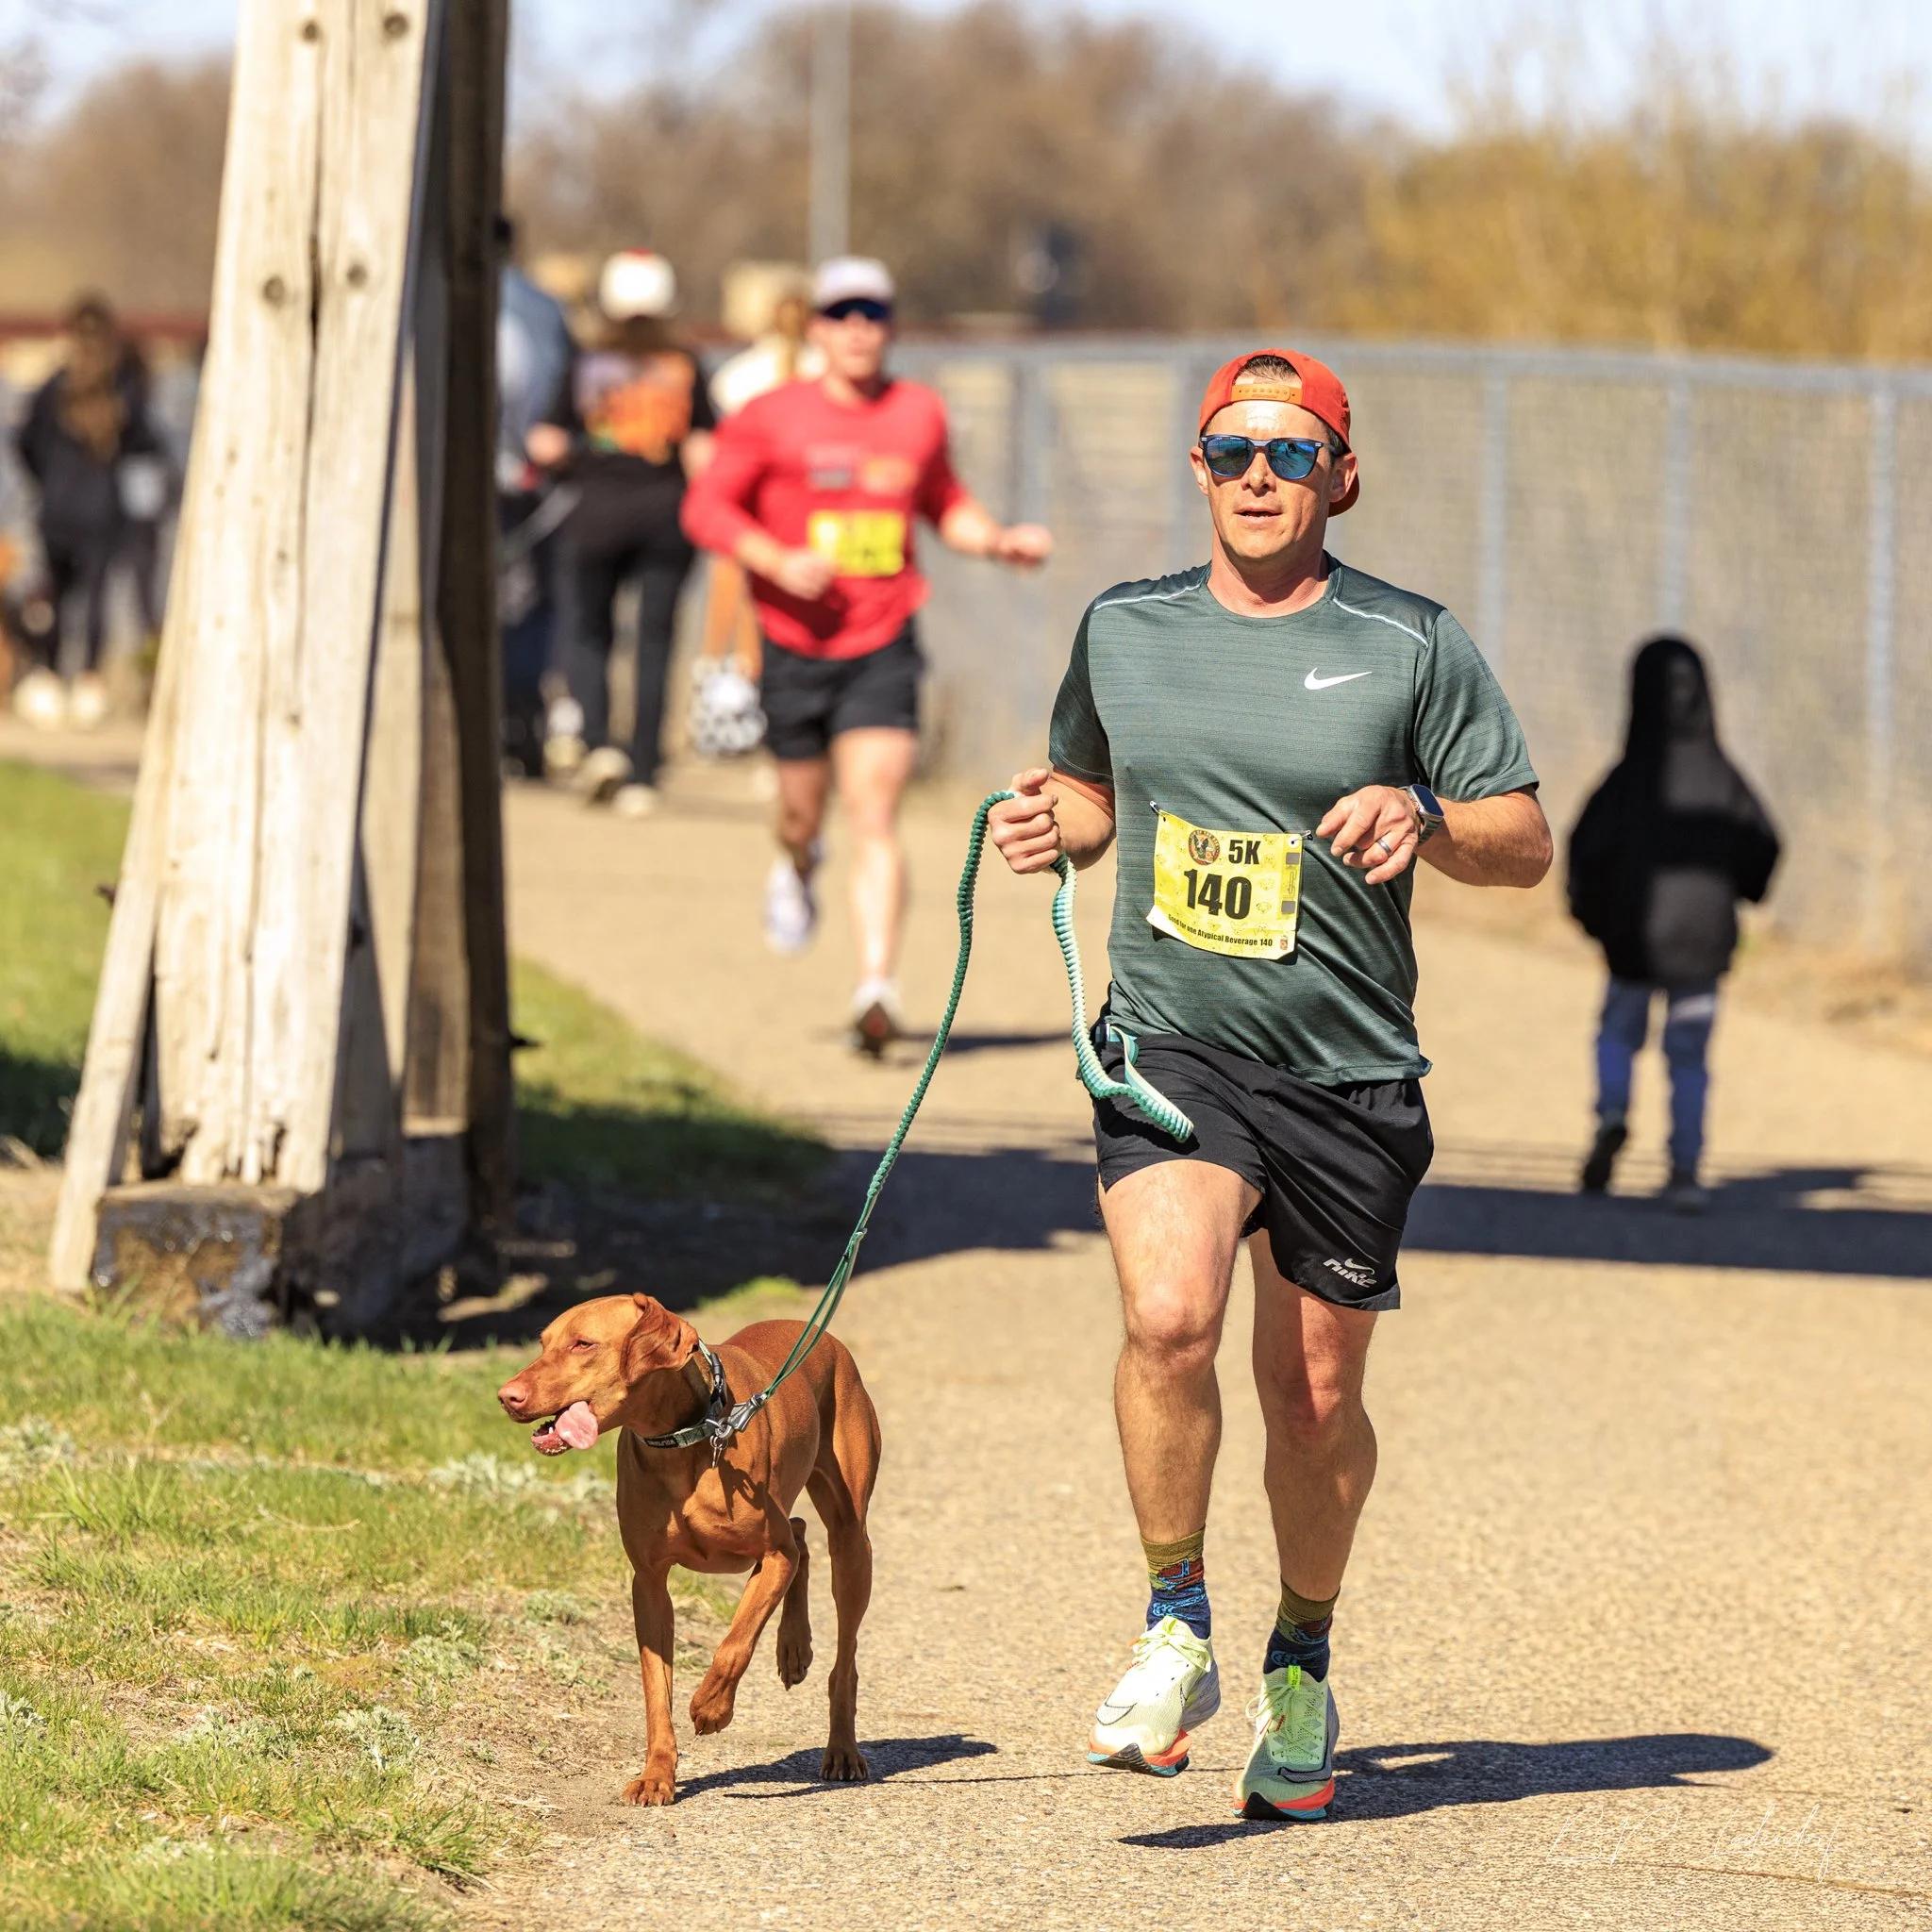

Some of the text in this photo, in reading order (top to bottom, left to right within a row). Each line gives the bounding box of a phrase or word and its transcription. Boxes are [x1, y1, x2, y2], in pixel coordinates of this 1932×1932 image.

[1228, 840, 1261, 865] 5K
[1184, 868, 1252, 920] 140
[1187, 926, 1196, 935] one
[1197, 929, 1224, 941] Atypical
[1224, 936, 1257, 946] Beverage
